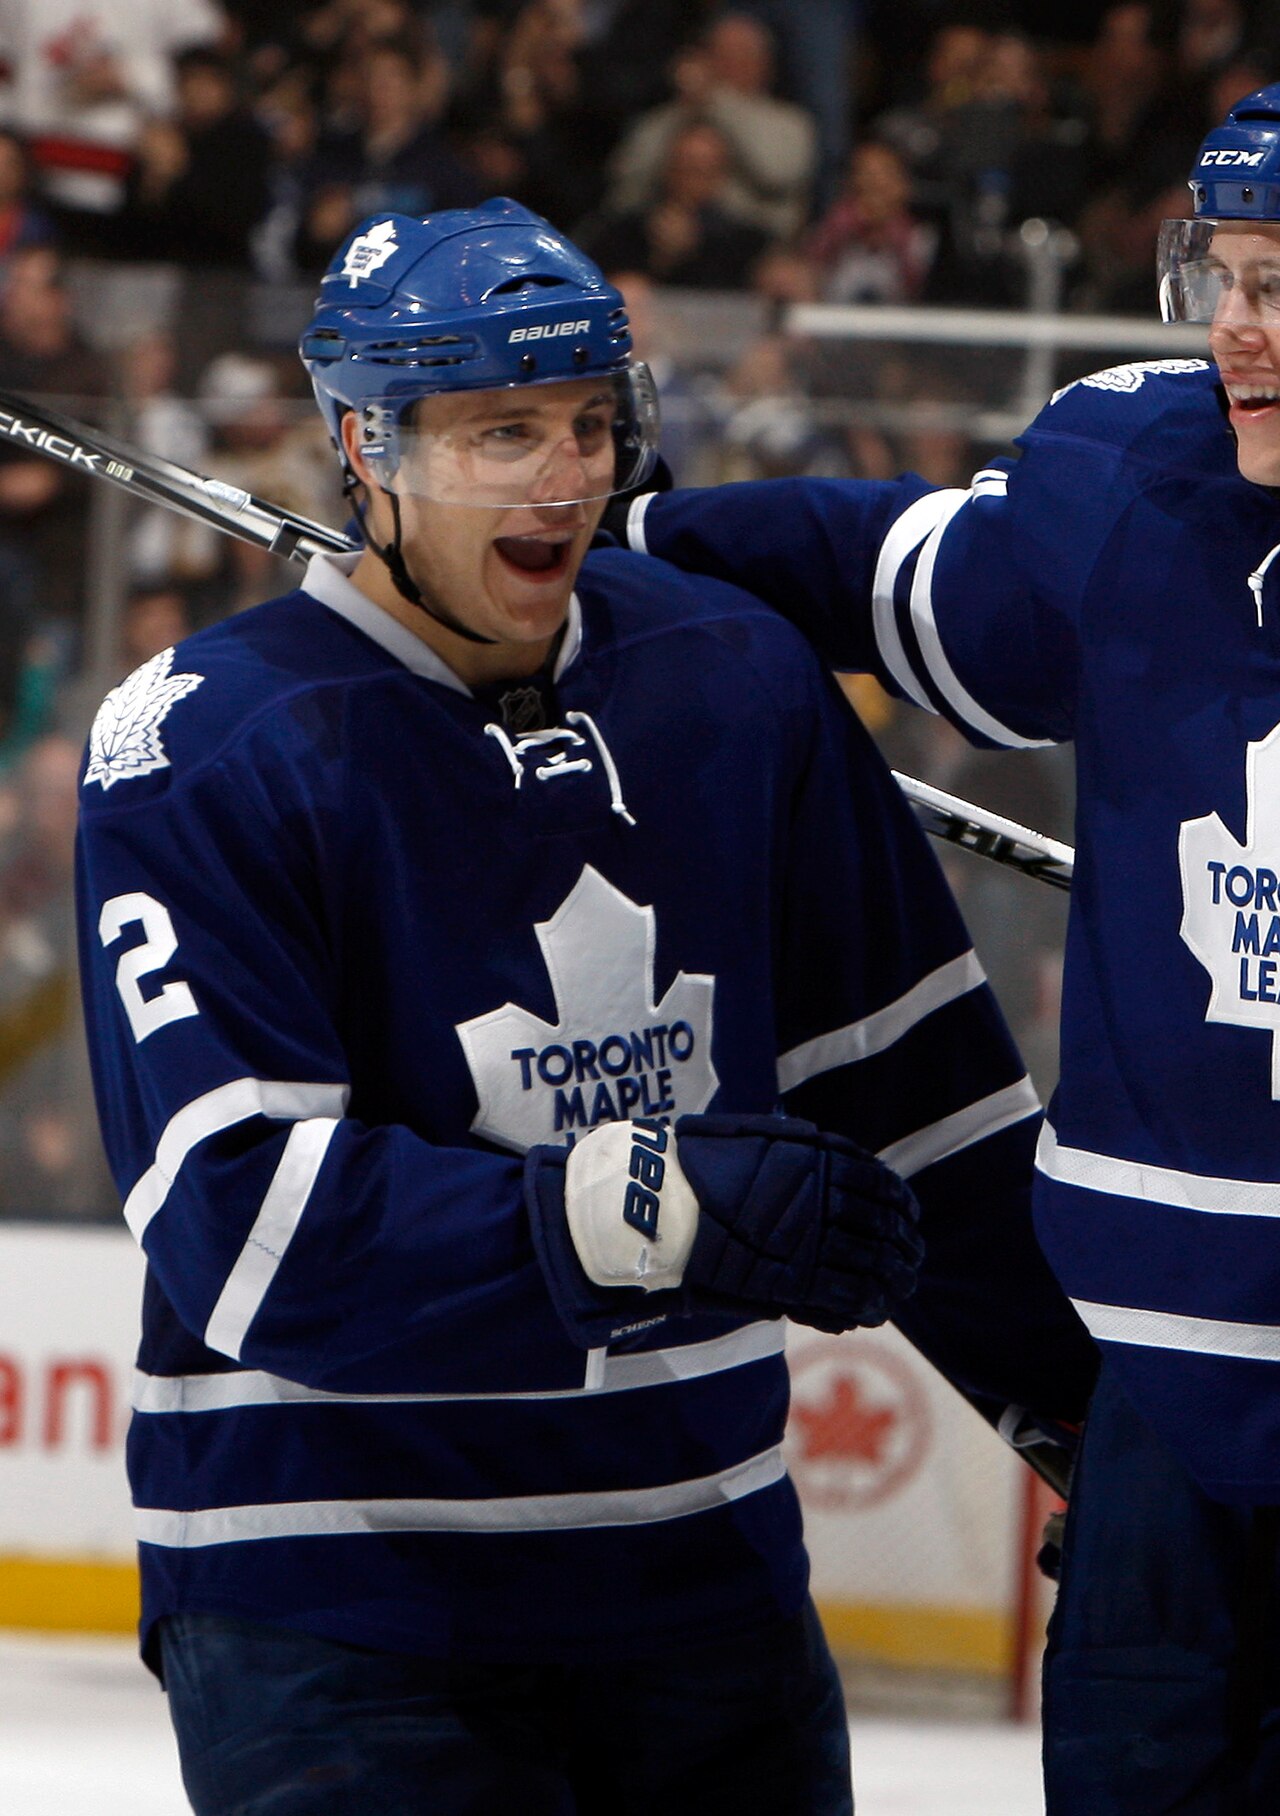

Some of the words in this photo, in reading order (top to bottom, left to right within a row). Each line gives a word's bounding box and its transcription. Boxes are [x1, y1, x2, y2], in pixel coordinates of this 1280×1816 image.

[1200, 150, 1265, 167] CCM
[507, 319, 592, 344] BAUER
[98, 891, 200, 1044] 2
[511, 1020, 695, 1091] TORONTO
[553, 1069, 676, 1132] MAPLE
